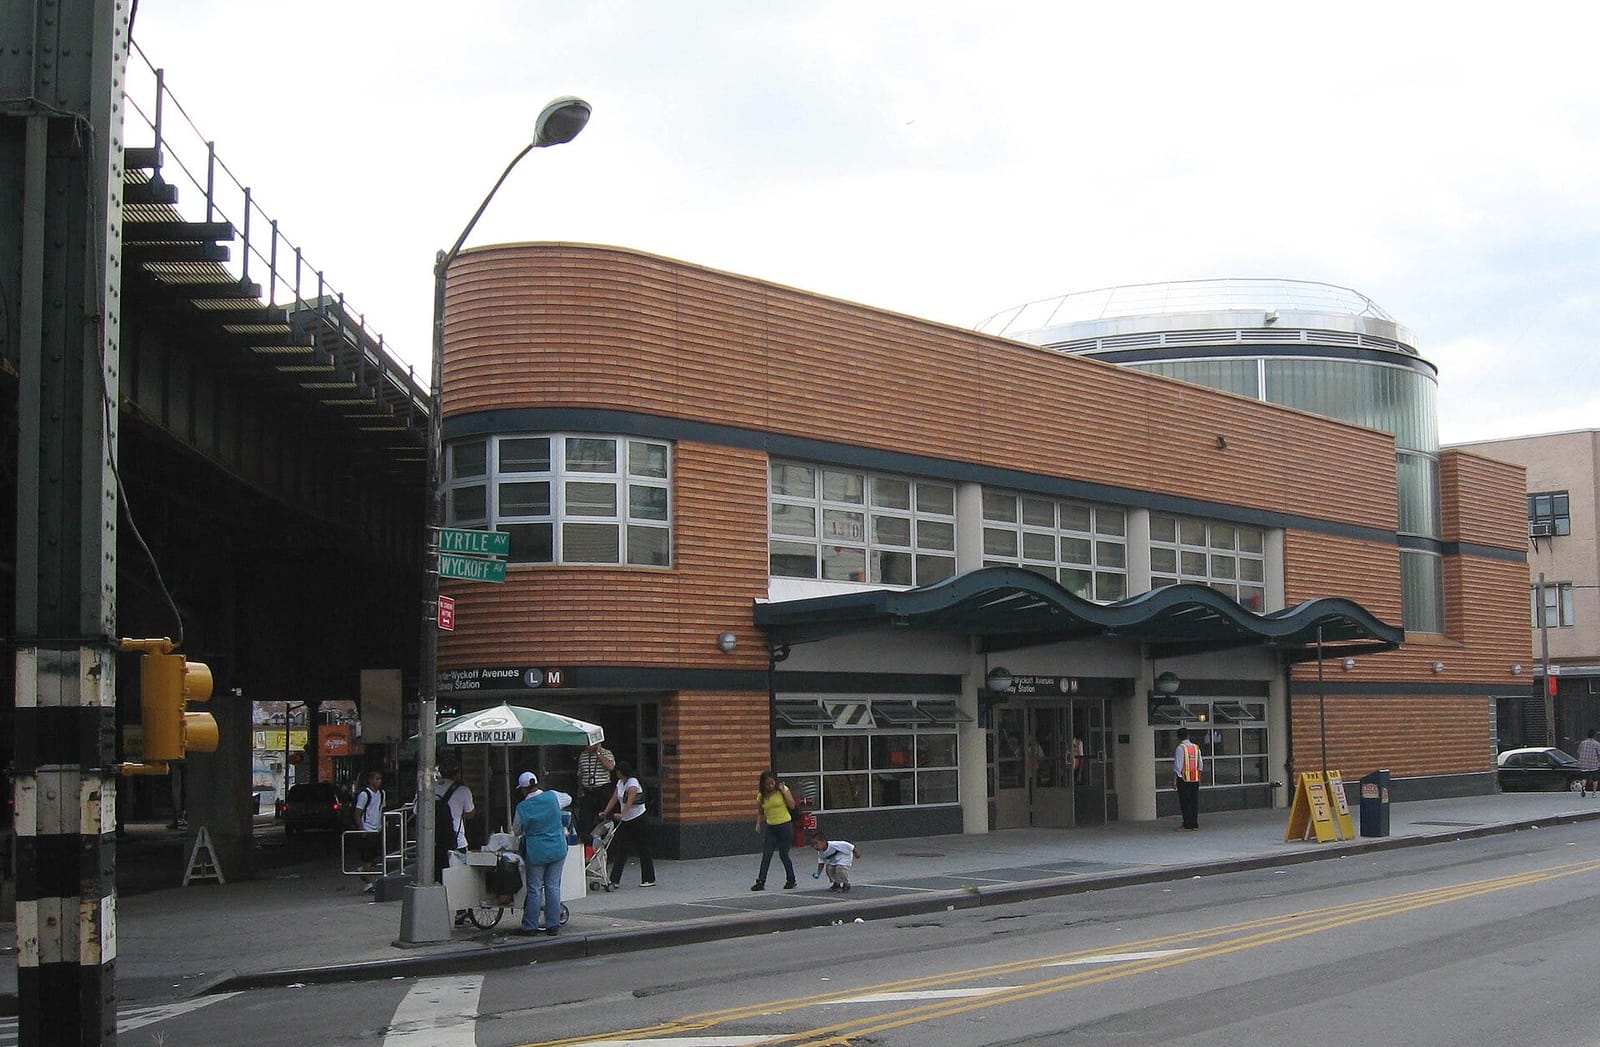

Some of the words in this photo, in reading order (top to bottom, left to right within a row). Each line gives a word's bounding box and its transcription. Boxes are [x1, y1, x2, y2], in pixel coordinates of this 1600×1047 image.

[439, 531, 488, 551] YRTLE
[494, 535, 506, 544] AV
[442, 557, 490, 578] WYCKOFF
[482, 669, 519, 678] Avenues
[548, 672, 560, 683] M
[455, 680, 480, 690] Station
[454, 731, 472, 742] KEEP
[474, 730, 492, 741] PARK
[494, 730, 516, 741] CLEAN
